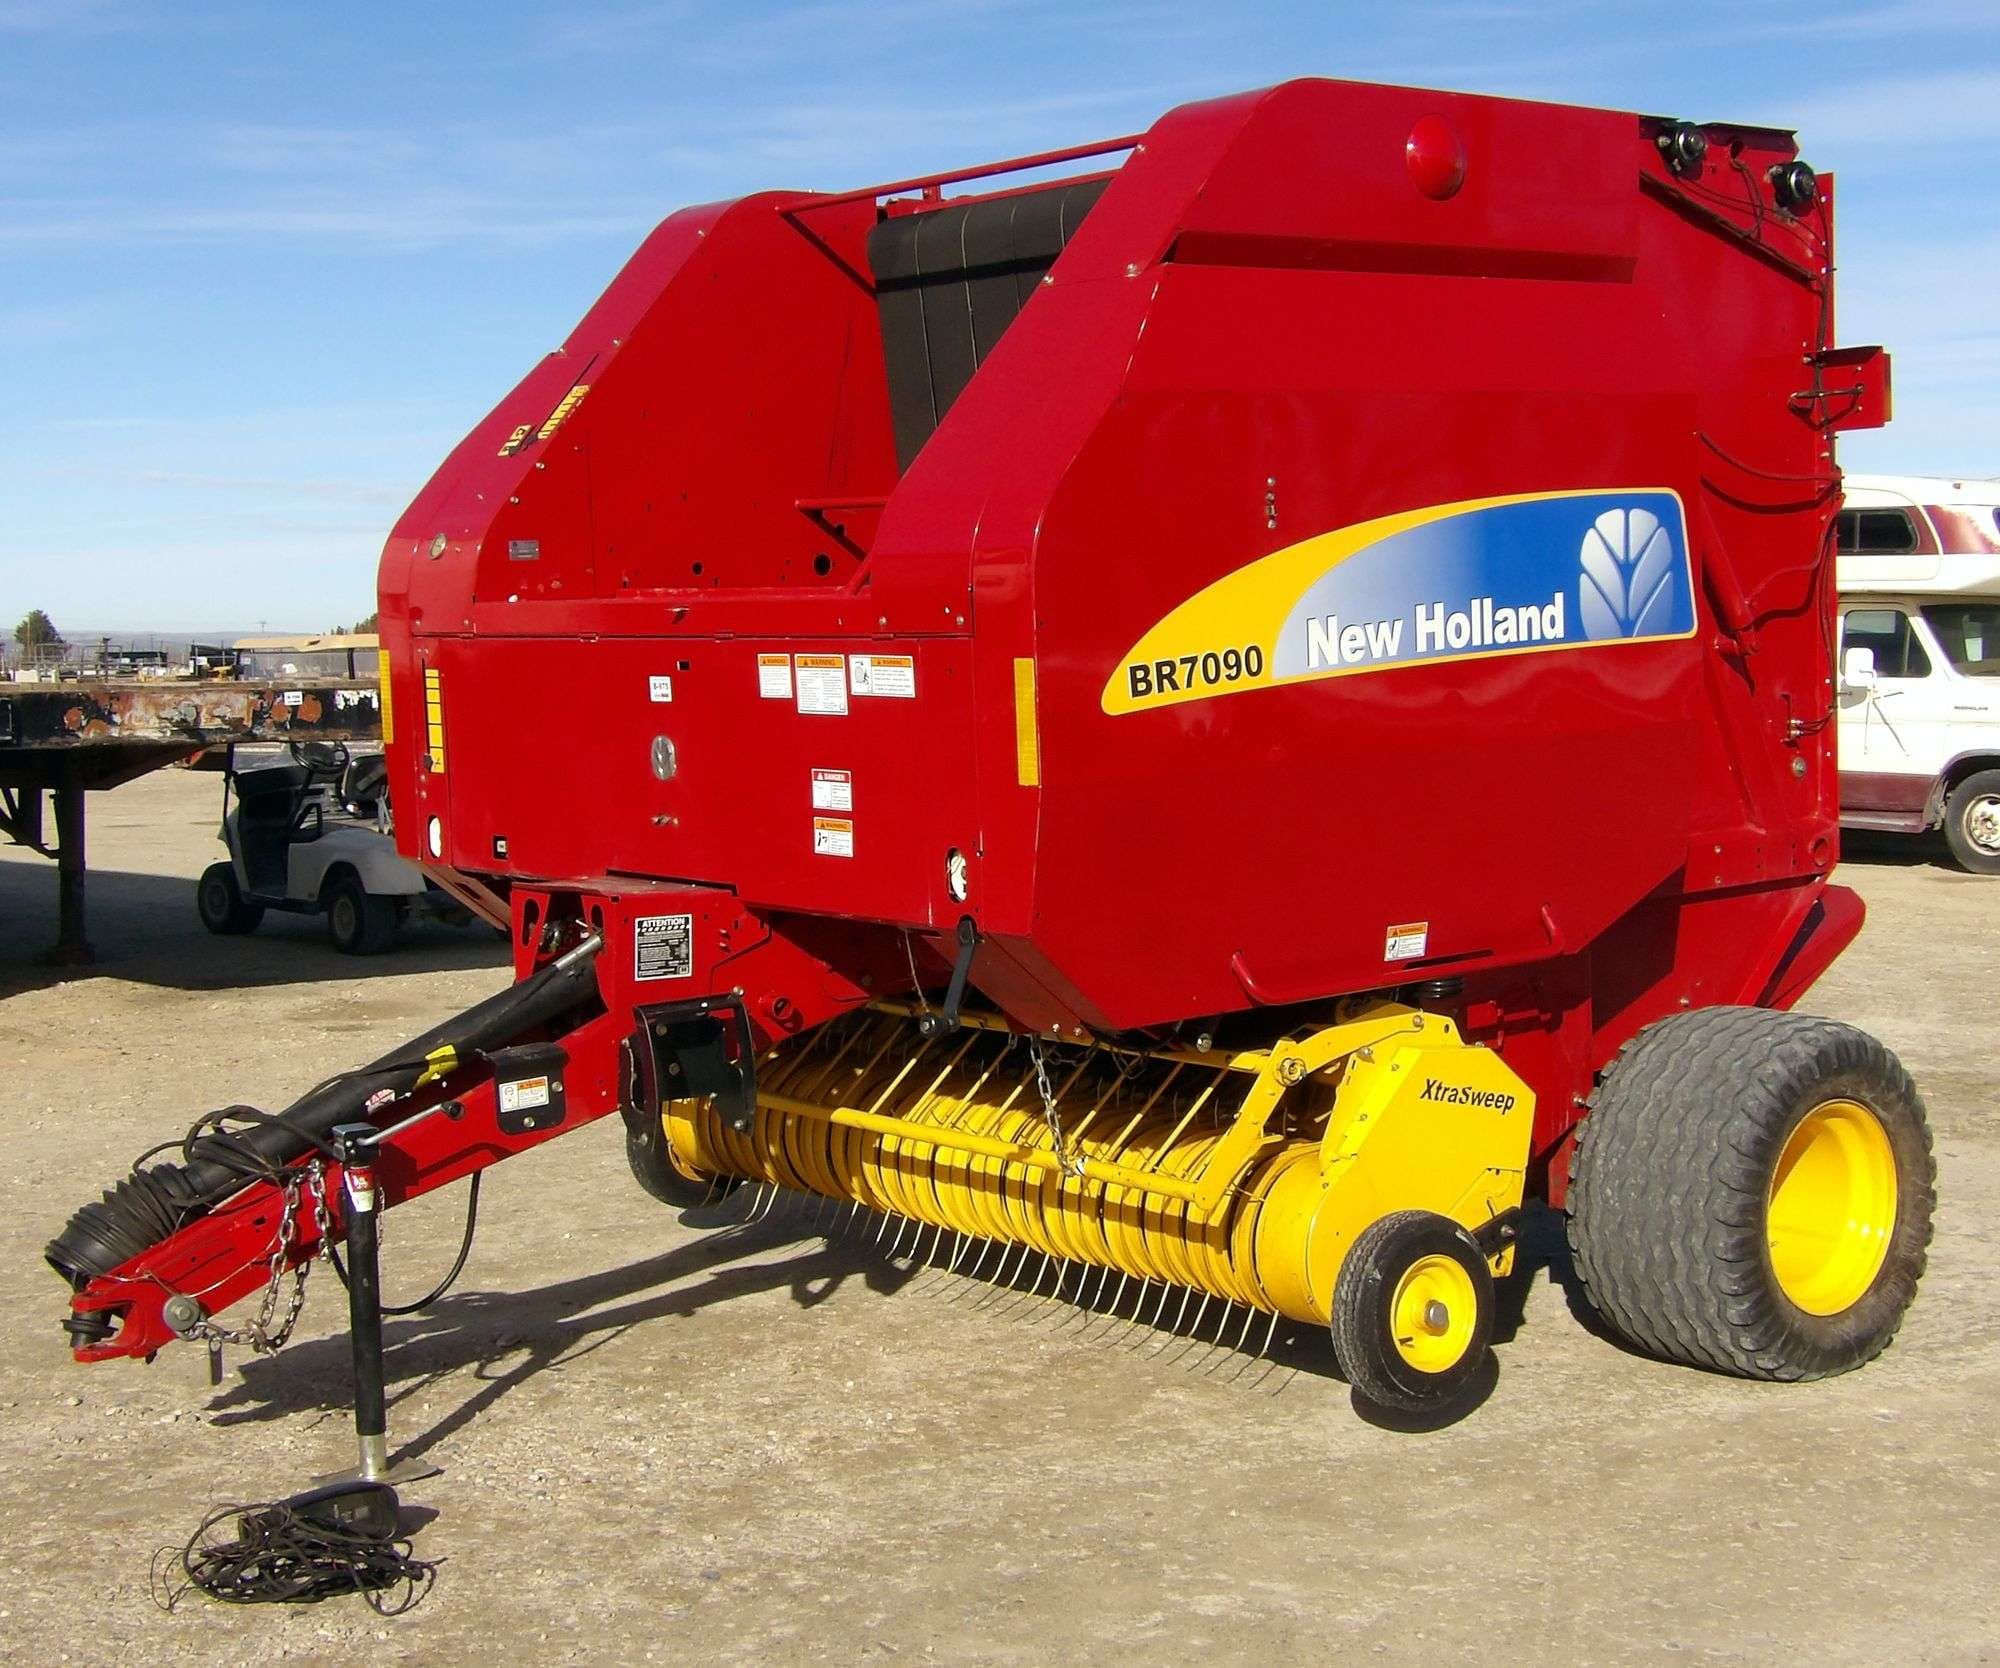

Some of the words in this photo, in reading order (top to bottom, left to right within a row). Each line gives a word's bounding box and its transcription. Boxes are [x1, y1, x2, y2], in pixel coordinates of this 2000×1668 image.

[1307, 614, 1403, 668] New
[1415, 591, 1565, 653] Holland
[1129, 645, 1263, 698] BR7090
[642, 917, 685, 928] ATTENTION
[1420, 1078, 1515, 1116] XtraSweep
